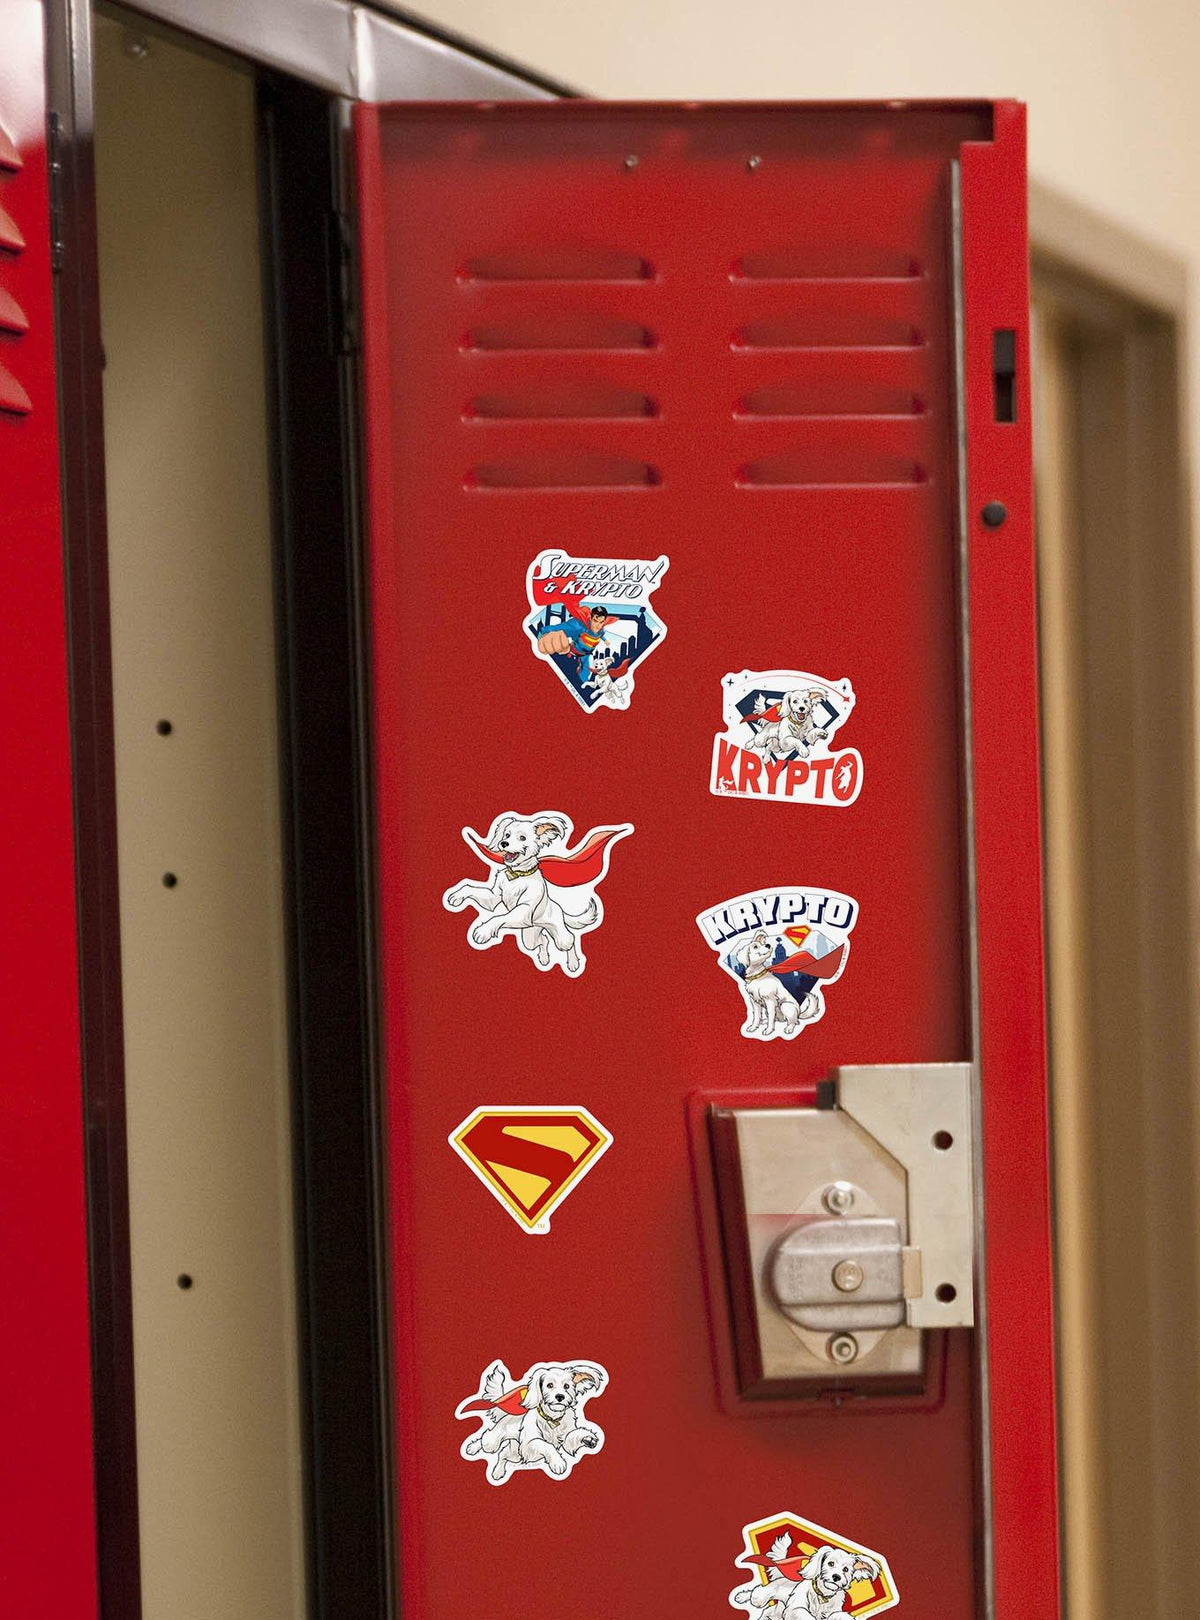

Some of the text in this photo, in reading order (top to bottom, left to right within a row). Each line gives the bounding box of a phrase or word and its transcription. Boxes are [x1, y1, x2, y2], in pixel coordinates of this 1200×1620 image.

[532, 554, 665, 583] SUPERMAN
[543, 580, 643, 599] & KRYPTO
[716, 738, 858, 801] KRYPTO
[701, 893, 854, 945] KRYPTO
